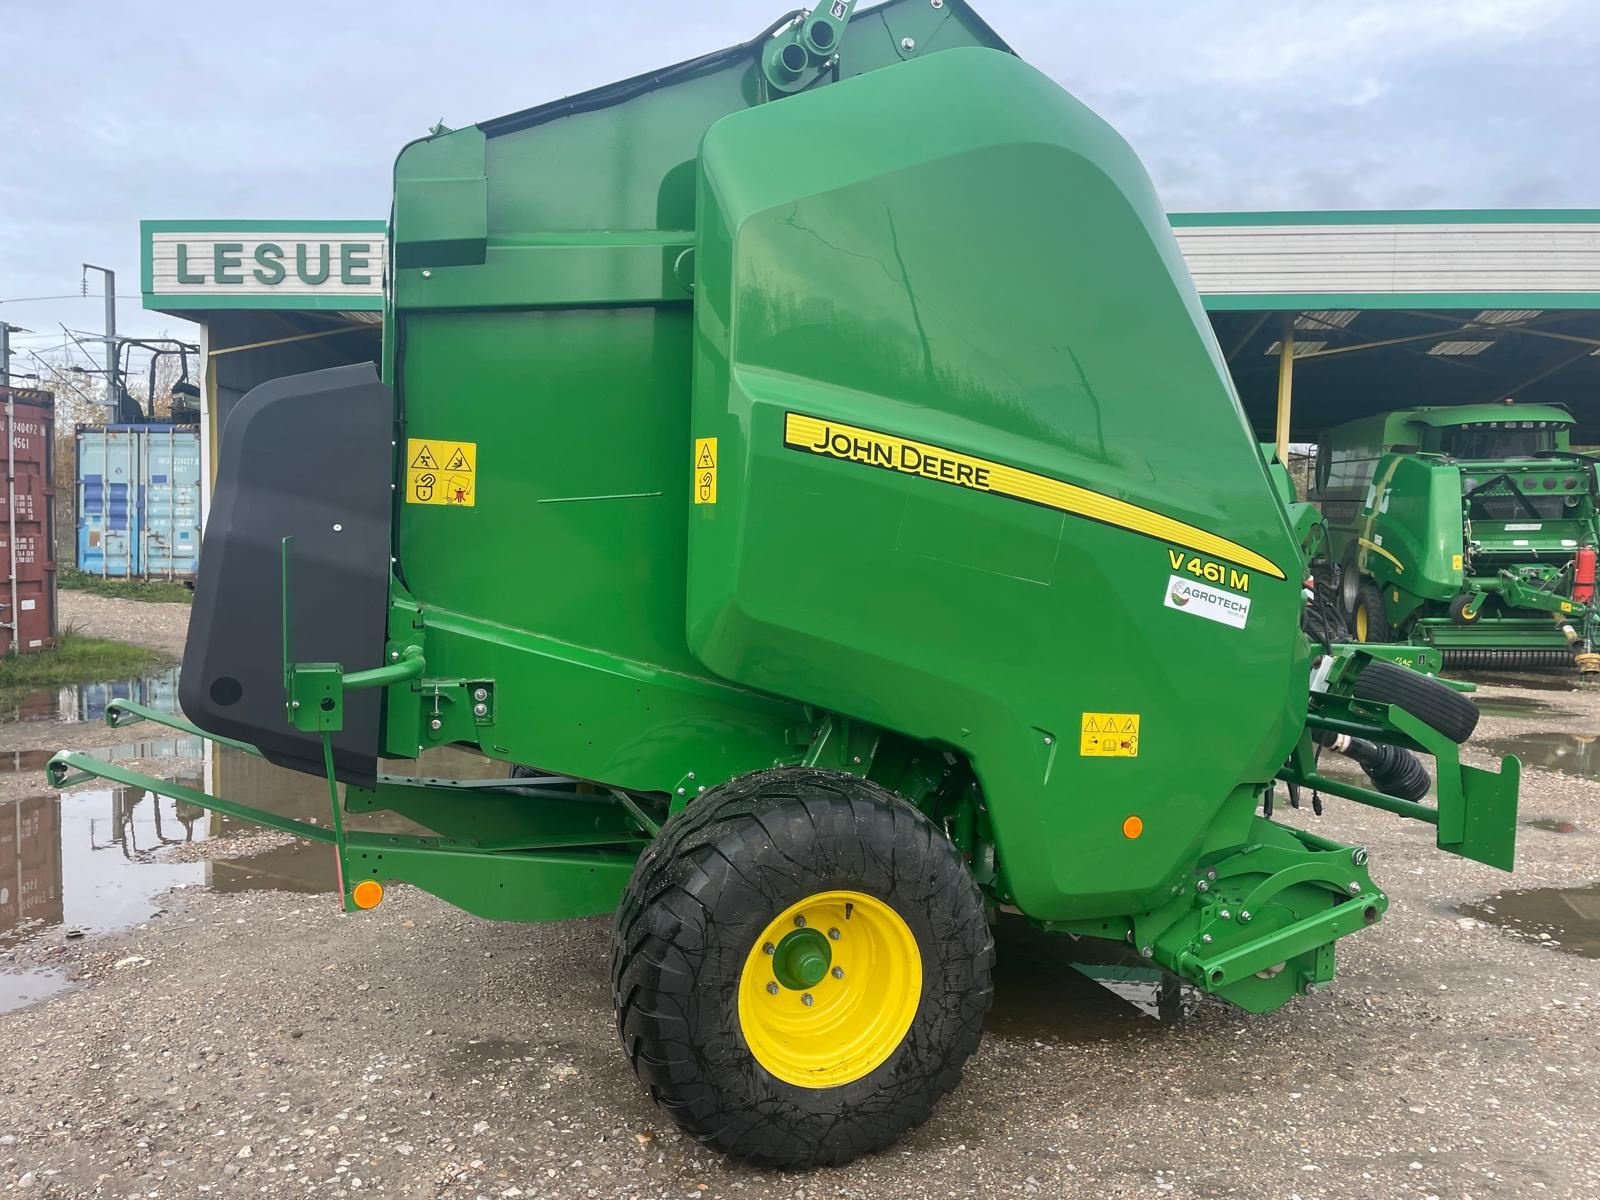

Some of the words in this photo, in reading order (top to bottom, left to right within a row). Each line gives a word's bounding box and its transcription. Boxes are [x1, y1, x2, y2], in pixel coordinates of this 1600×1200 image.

[177, 243, 384, 285] LESUE
[814, 427, 892, 465] JOHN
[901, 445, 990, 488] DEERE
[1168, 549, 1185, 570] V
[1187, 557, 1226, 585] 461
[1230, 569, 1249, 592] M
[1183, 586, 1248, 614] AGROTECH
